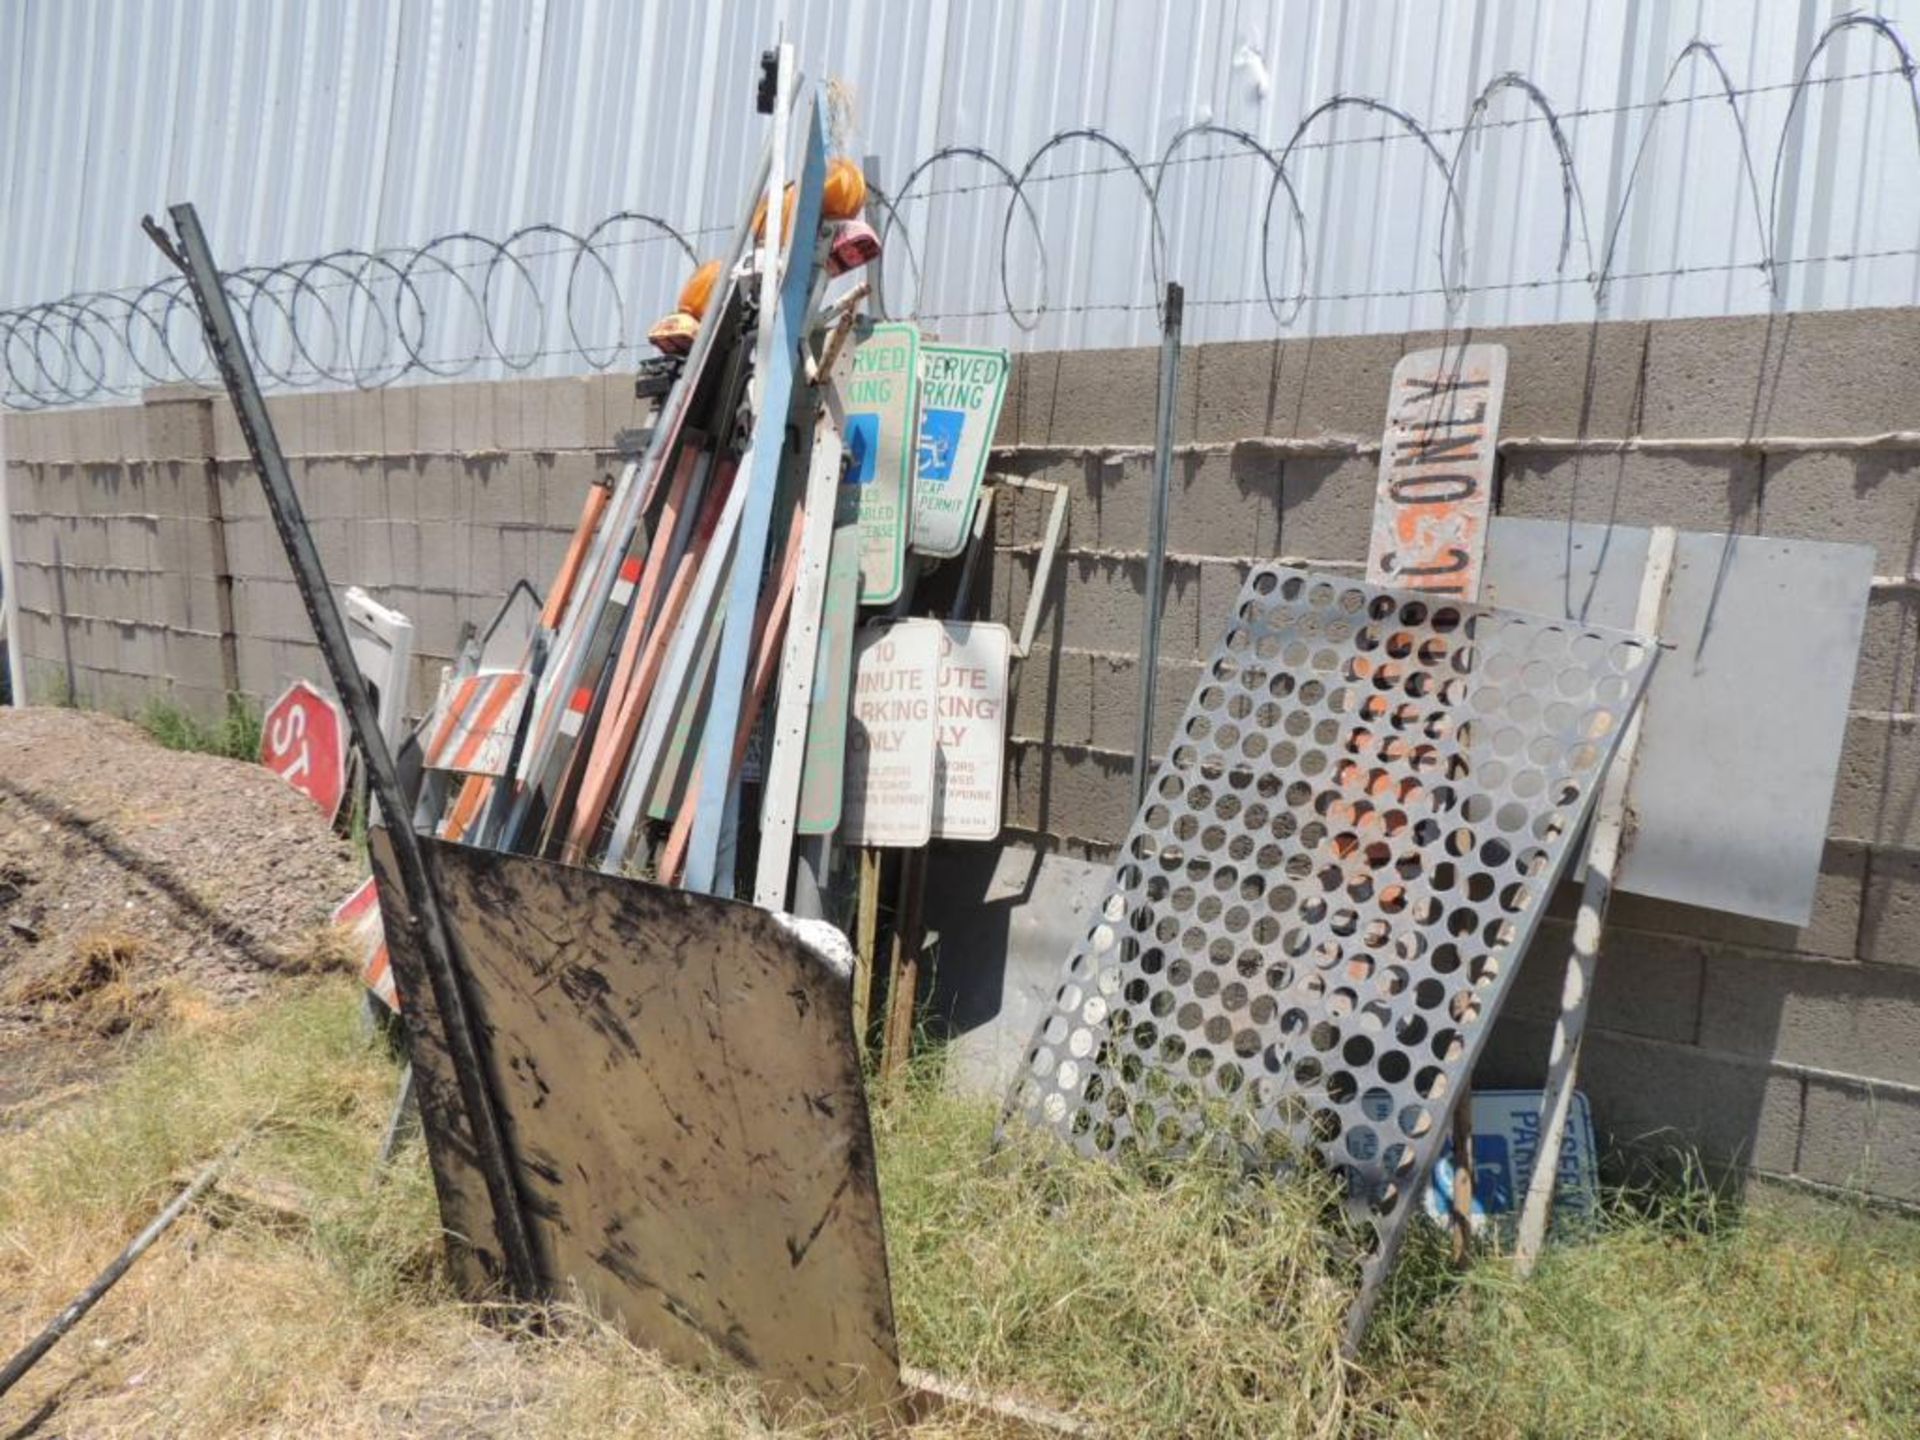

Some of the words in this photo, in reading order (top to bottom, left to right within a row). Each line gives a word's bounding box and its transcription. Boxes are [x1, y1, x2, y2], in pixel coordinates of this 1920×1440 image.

[1390, 377, 1490, 504] ONLY
[874, 641, 895, 662] 10
[853, 730, 905, 752] ONLY
